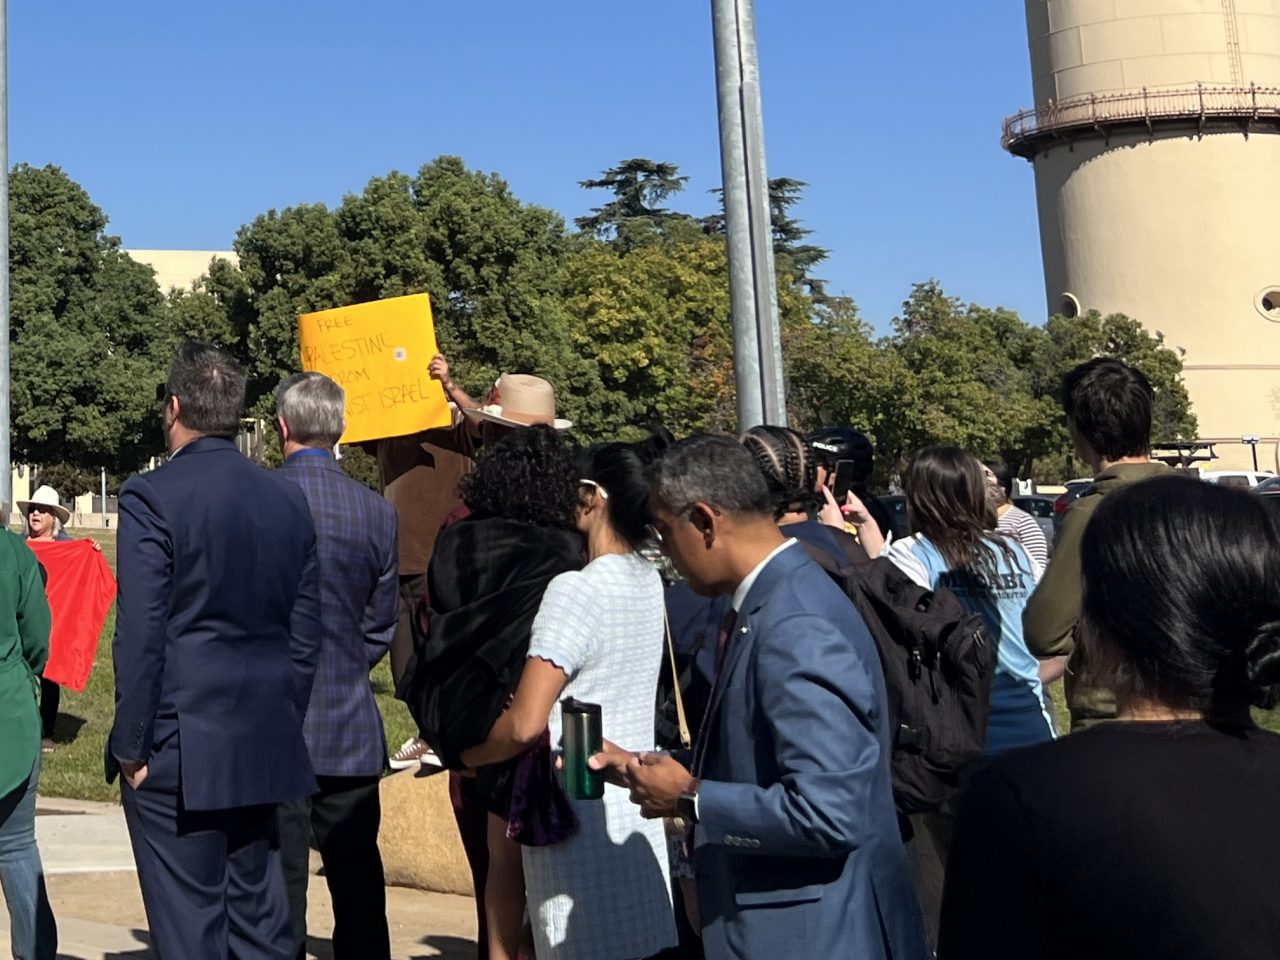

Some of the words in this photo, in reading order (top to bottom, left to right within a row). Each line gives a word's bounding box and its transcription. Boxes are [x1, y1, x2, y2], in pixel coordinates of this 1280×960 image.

[317, 315, 352, 333] FREE
[304, 330, 398, 371] PALESTINE
[377, 378, 431, 409] ISRAEL
[811, 441, 839, 452] POLICE
